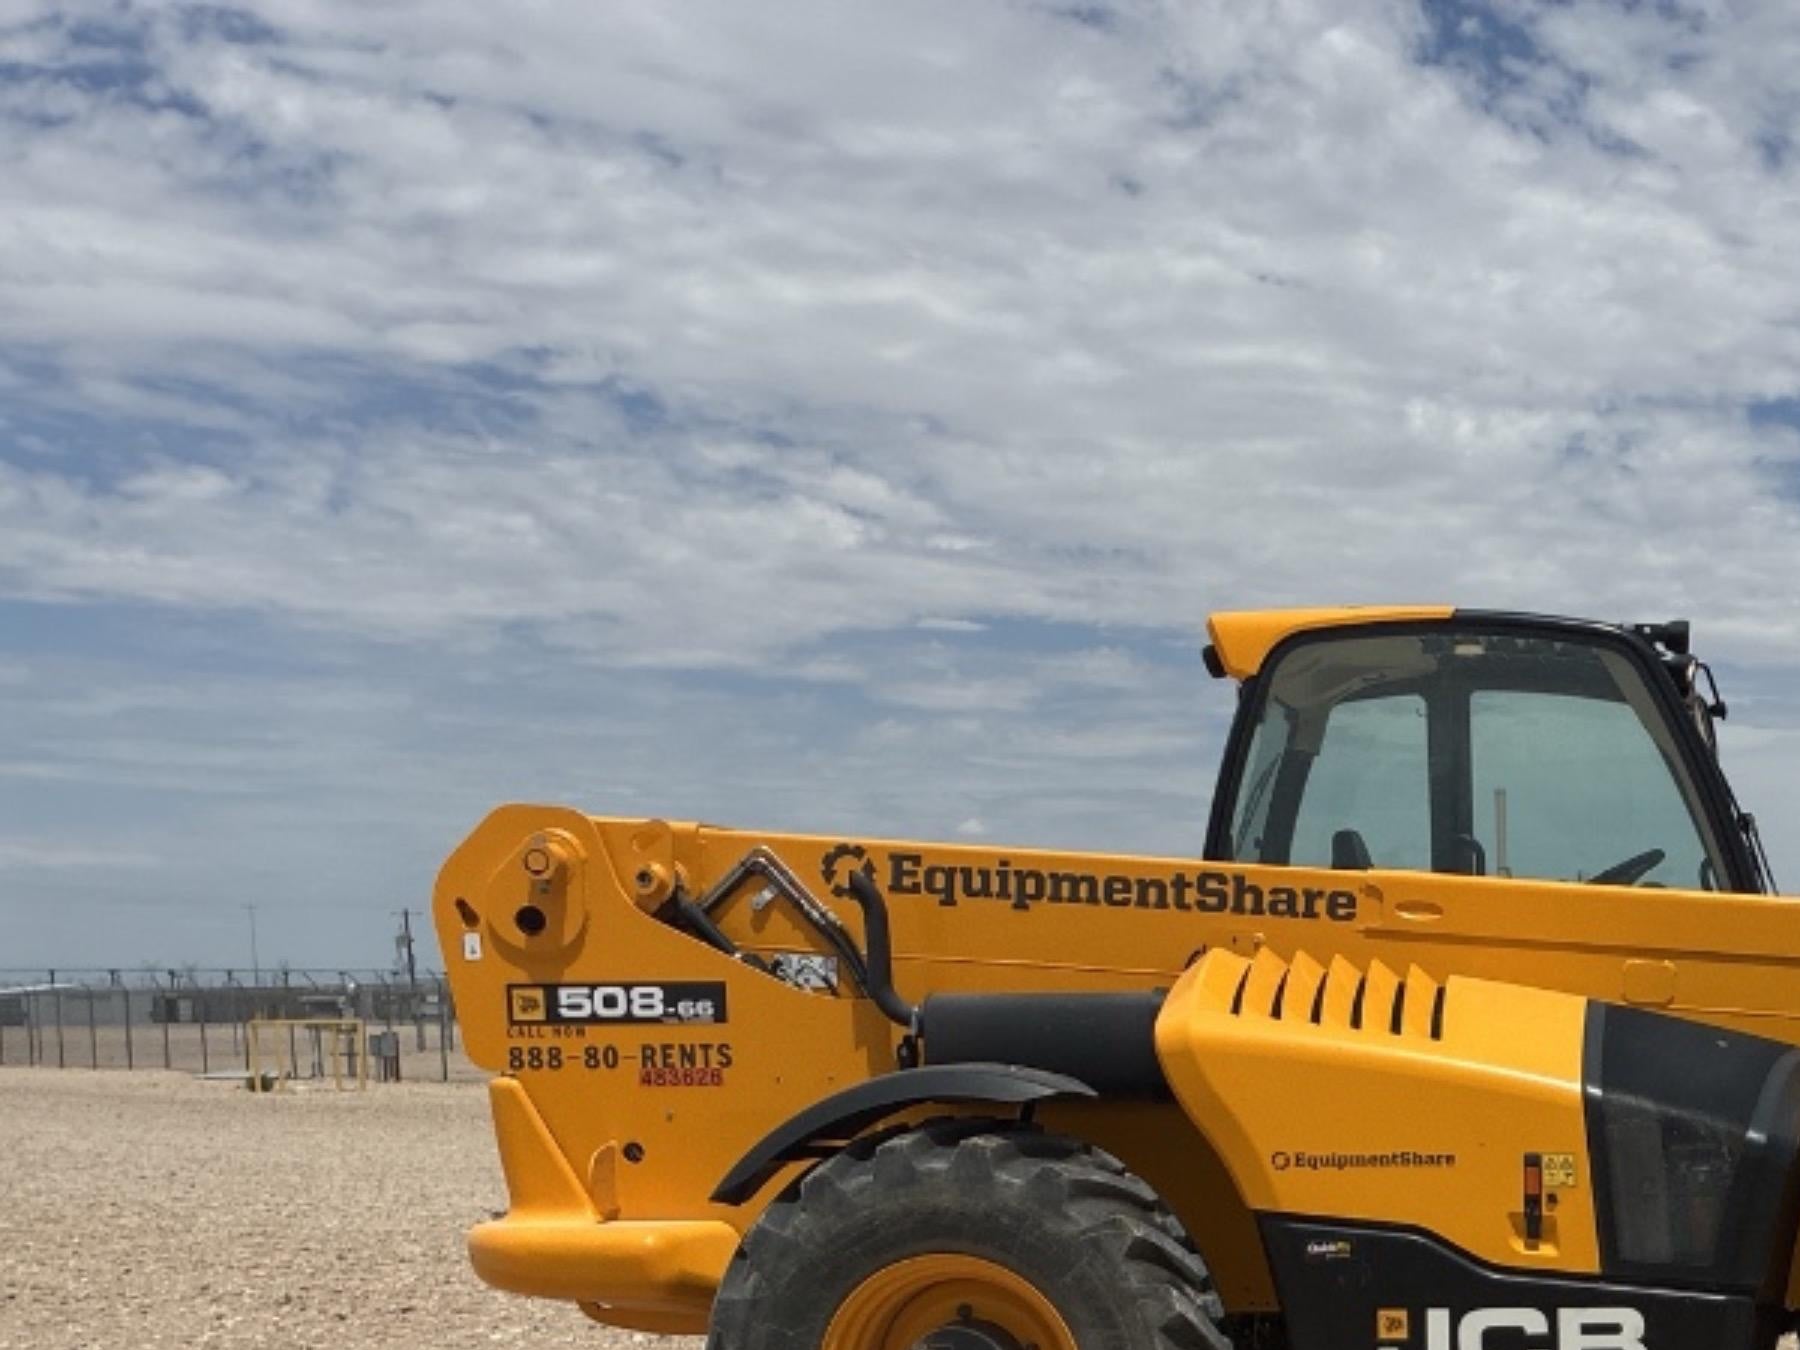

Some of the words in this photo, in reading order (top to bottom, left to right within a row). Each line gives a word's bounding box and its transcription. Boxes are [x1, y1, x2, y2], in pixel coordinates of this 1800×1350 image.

[887, 852, 1358, 921] EquipmentShare
[507, 1025, 545, 1038] CALL
[509, 1043, 733, 1070] 888-80-RENTS
[1294, 1152, 1456, 1171] EquipmentShare
